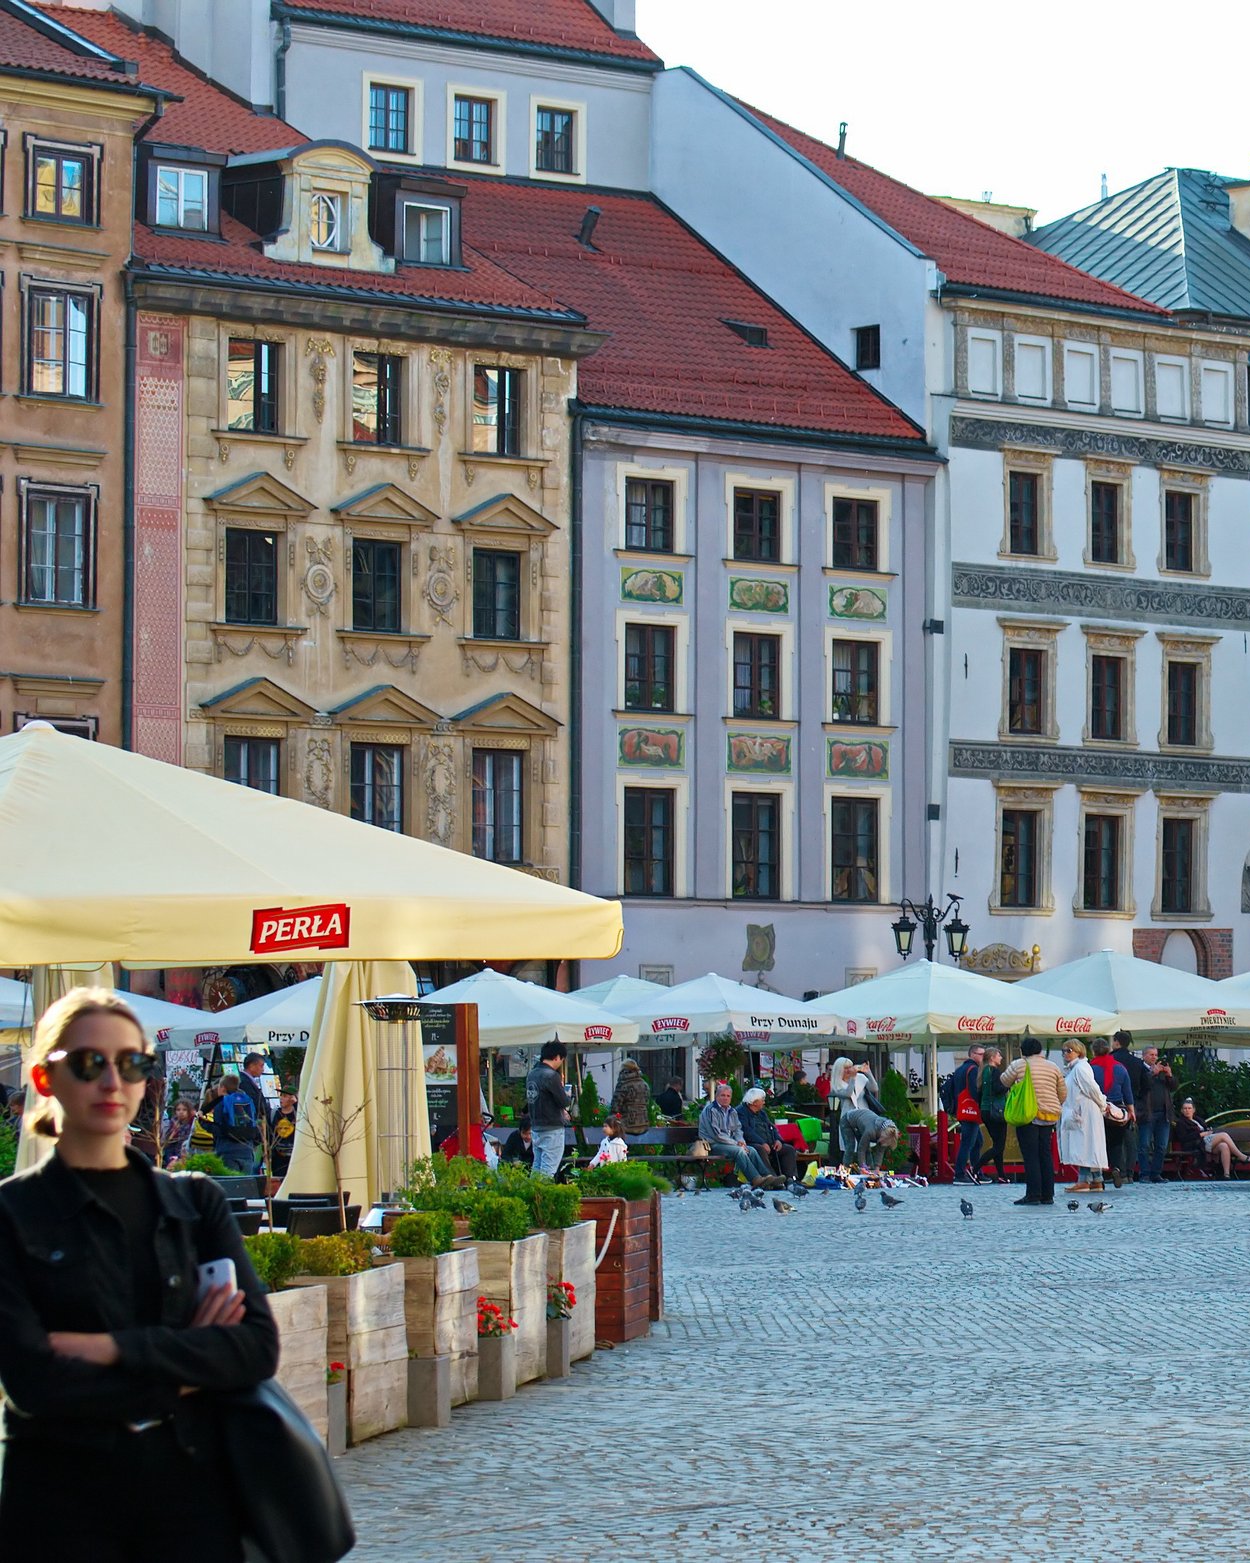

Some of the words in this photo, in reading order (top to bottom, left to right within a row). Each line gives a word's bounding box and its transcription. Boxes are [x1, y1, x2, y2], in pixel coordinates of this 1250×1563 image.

[258, 913, 342, 943] PERŁA
[750, 1016, 774, 1029] Przy
[778, 1017, 818, 1030] Dunaju
[957, 1016, 996, 1031] Coca-Cola
[1056, 1017, 1092, 1032] Coca-Cola
[268, 1030, 295, 1044] Przy
